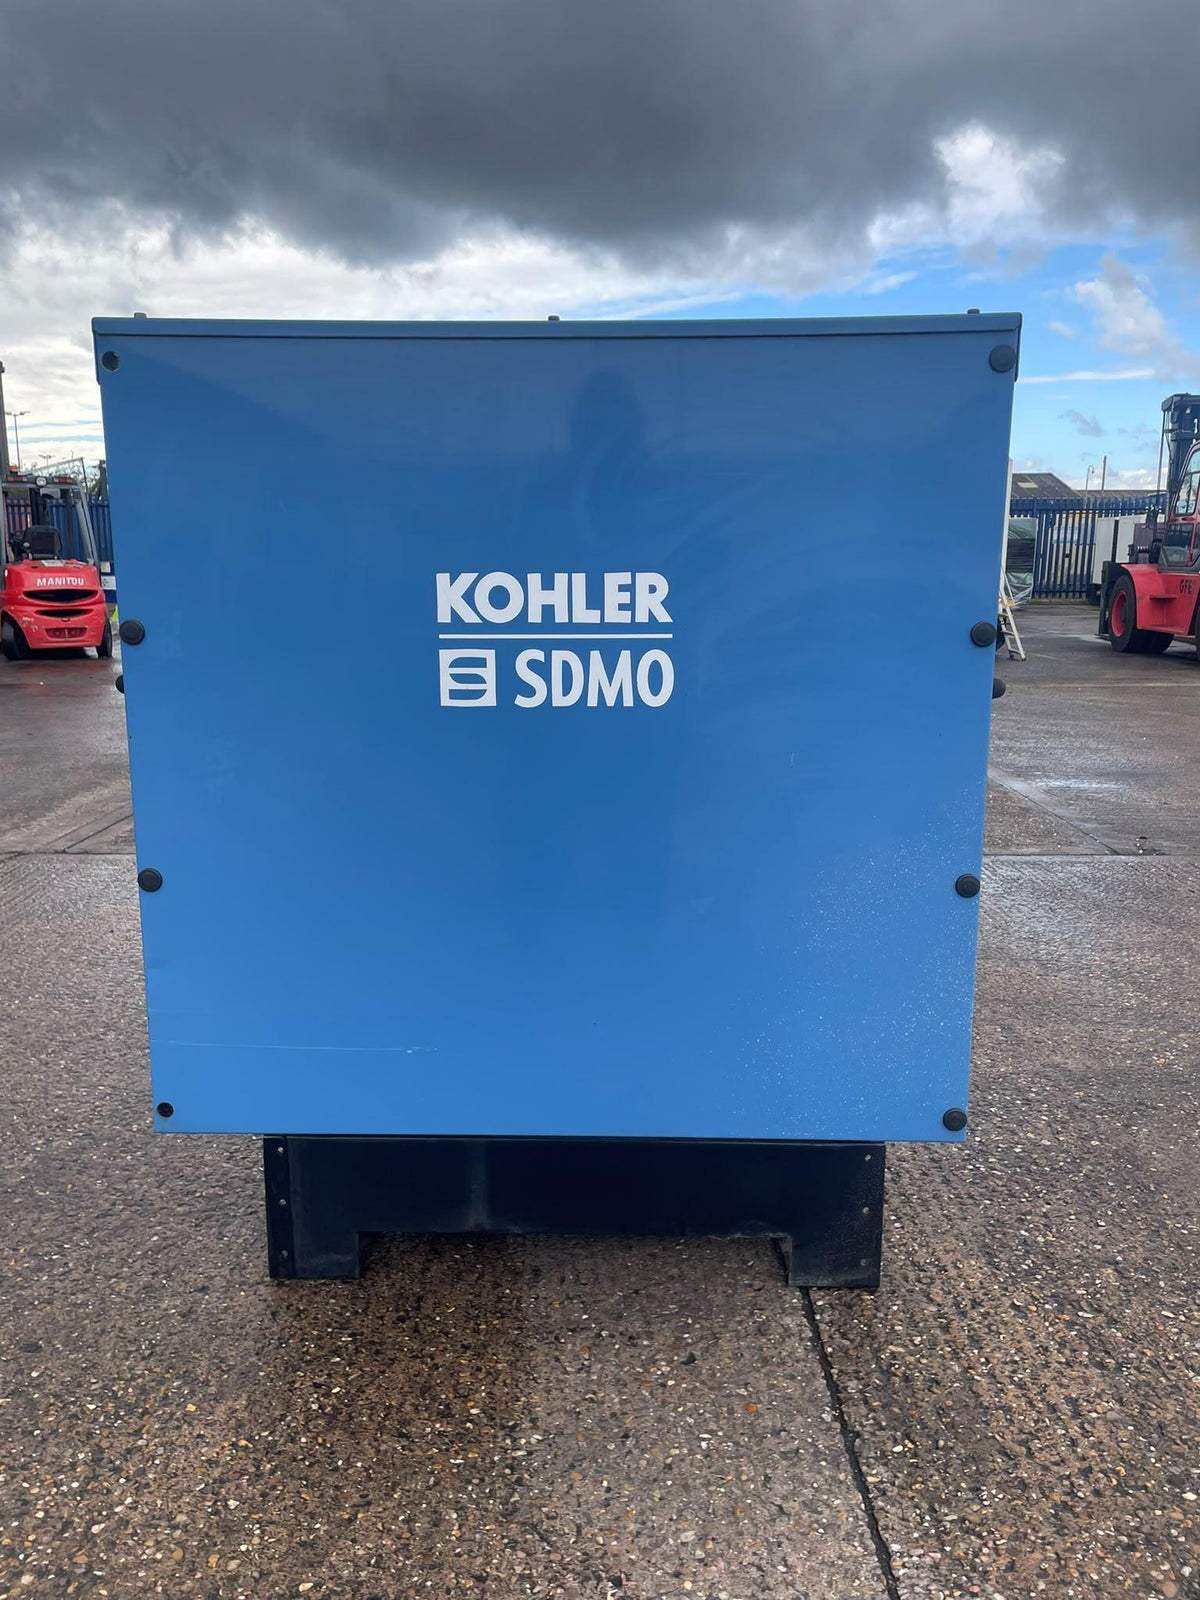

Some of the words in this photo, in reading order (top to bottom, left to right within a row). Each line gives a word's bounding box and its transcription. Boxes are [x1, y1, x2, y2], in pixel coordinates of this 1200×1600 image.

[36, 576, 85, 587] MANITOU
[435, 571, 674, 624] KOHLER
[513, 648, 675, 709] SDMO
